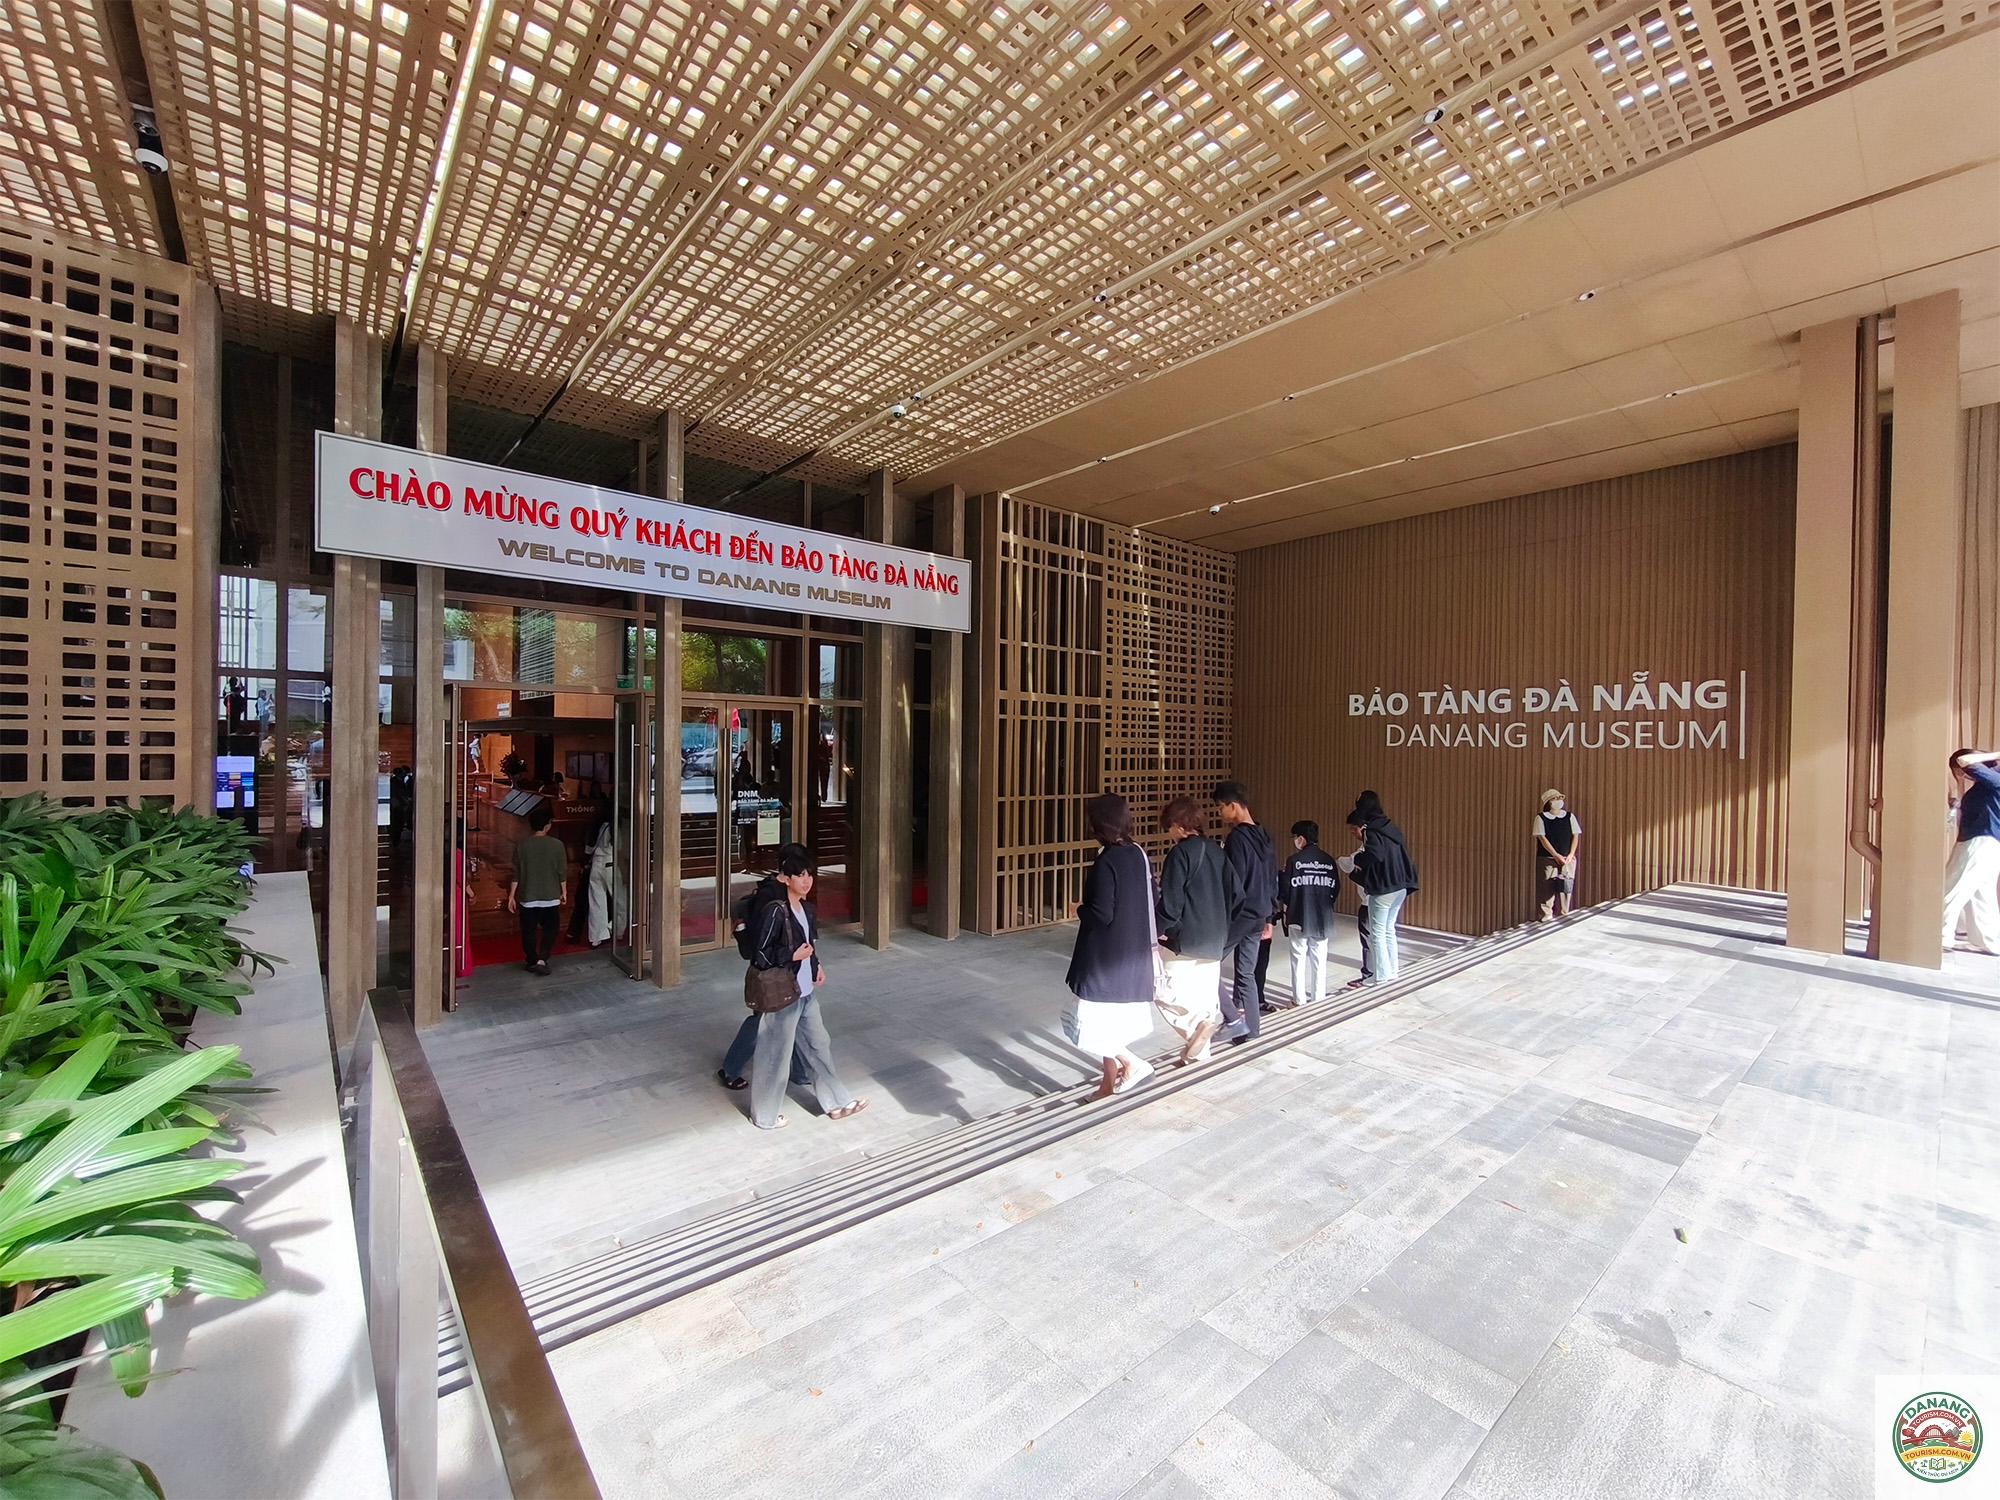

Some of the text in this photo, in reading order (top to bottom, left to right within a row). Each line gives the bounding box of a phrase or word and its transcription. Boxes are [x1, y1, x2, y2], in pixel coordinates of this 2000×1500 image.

[349, 467, 960, 596] CHÀO MỪNG QUÝ KHÁCH ĐẾN BẢO TÀNG ĐÀ NẴNG
[498, 537, 892, 610] WELCOME TO DANANG MUSEUM
[1348, 670, 1728, 717] BẢO TÀNG ĐÀ NẴNG
[1386, 720, 1728, 750] DANANG MUSEUM
[737, 790, 759, 798] DNM
